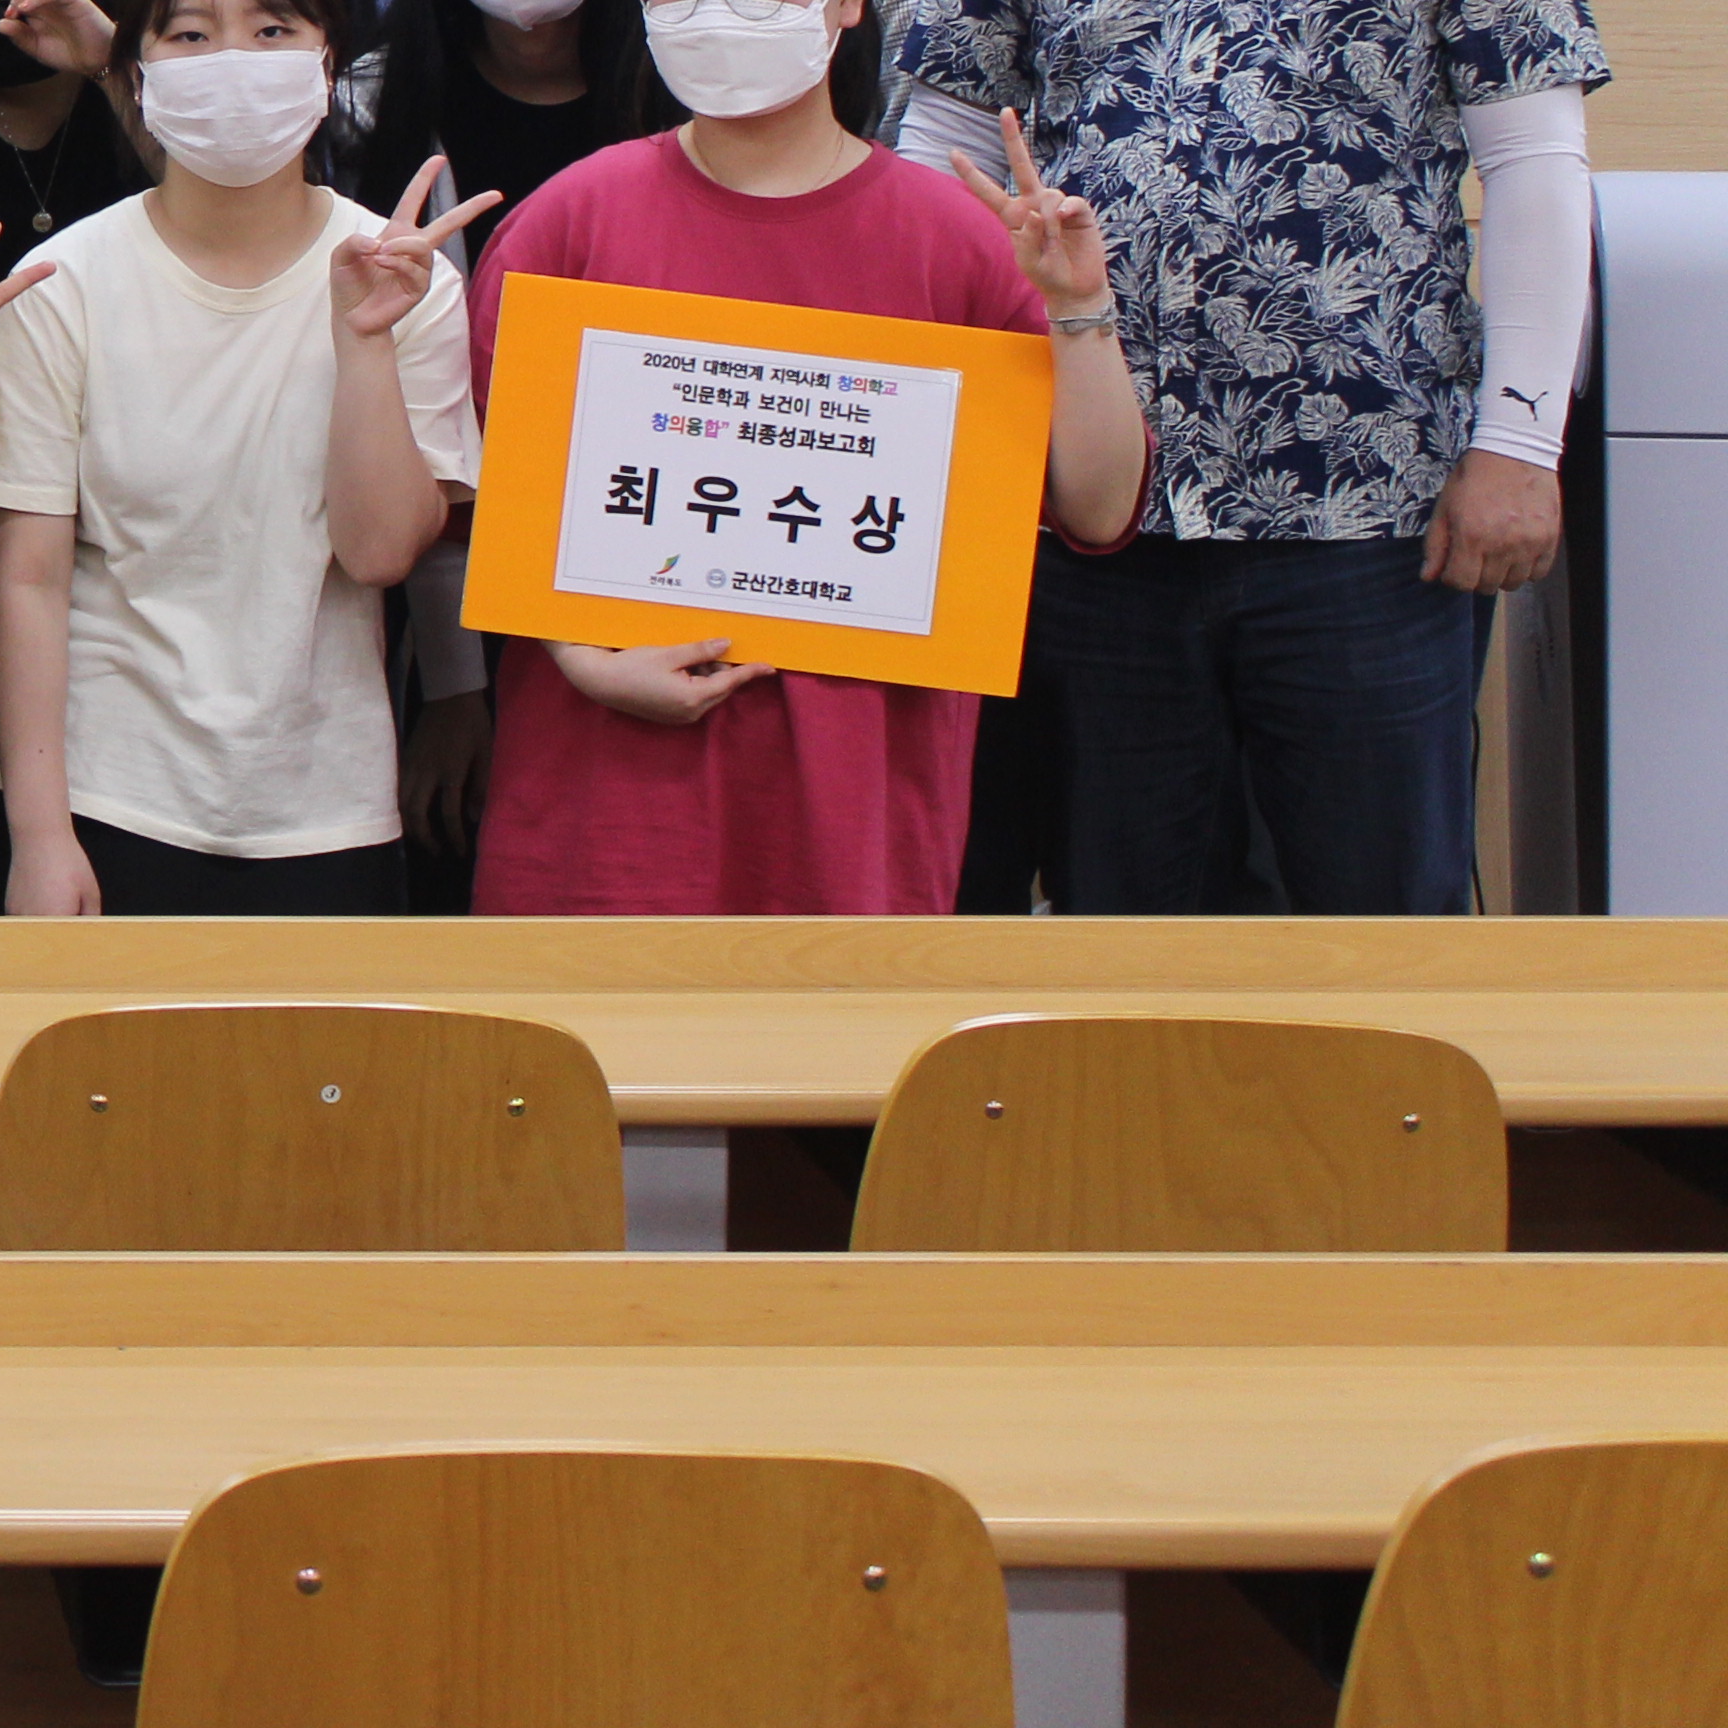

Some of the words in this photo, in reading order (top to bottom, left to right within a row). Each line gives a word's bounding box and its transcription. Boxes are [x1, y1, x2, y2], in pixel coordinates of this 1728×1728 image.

[643, 353, 696, 374] 2020년
[702, 360, 764, 382] 대학연계
[770, 366, 830, 390] 지역사회
[837, 374, 898, 397] 창의학교
[672, 382, 750, 410] “인문학과
[758, 392, 811, 418] 보건이
[819, 400, 872, 424] 만나는
[651, 412, 730, 439] 창의융합”
[737, 420, 876, 458] 최종성과보고회
[730, 571, 853, 602] 군산간호대학교
